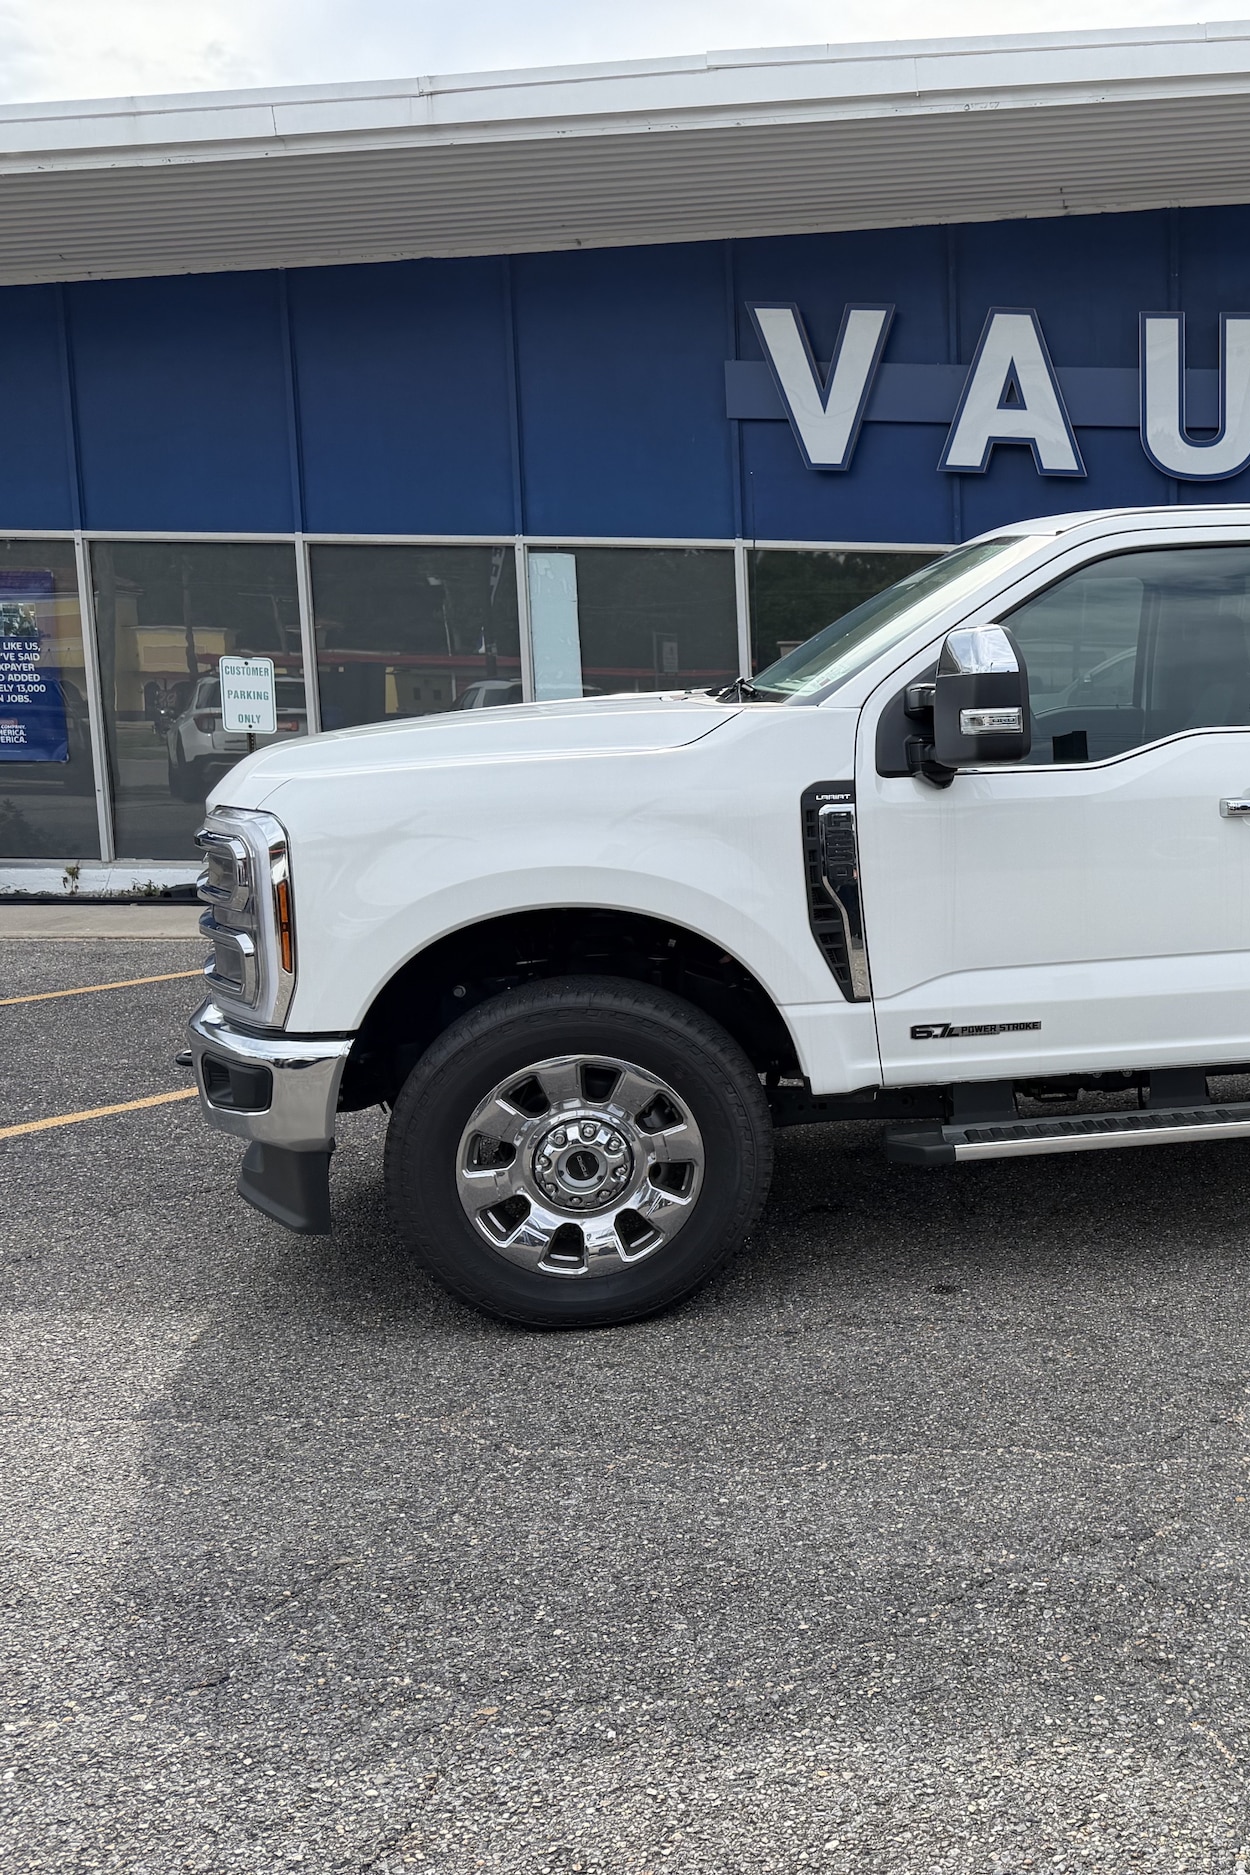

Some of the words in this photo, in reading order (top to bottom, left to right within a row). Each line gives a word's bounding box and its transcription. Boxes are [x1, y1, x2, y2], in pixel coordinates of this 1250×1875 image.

[3, 642, 23, 651] LIKE
[25, 642, 41, 652] US,
[18, 652, 40, 661] SAID
[224, 665, 270, 677] CUSTOMER
[7, 674, 41, 682] ADDED
[17, 684, 47, 694] 13,000
[6, 694, 33, 703] JOBS.
[227, 689, 270, 701] PARKING
[237, 713, 262, 725] ONLY
[815, 793, 851, 801] LARIAT
[960, 1024, 997, 1035] POWER
[999, 1021, 1041, 1033] STROKE
